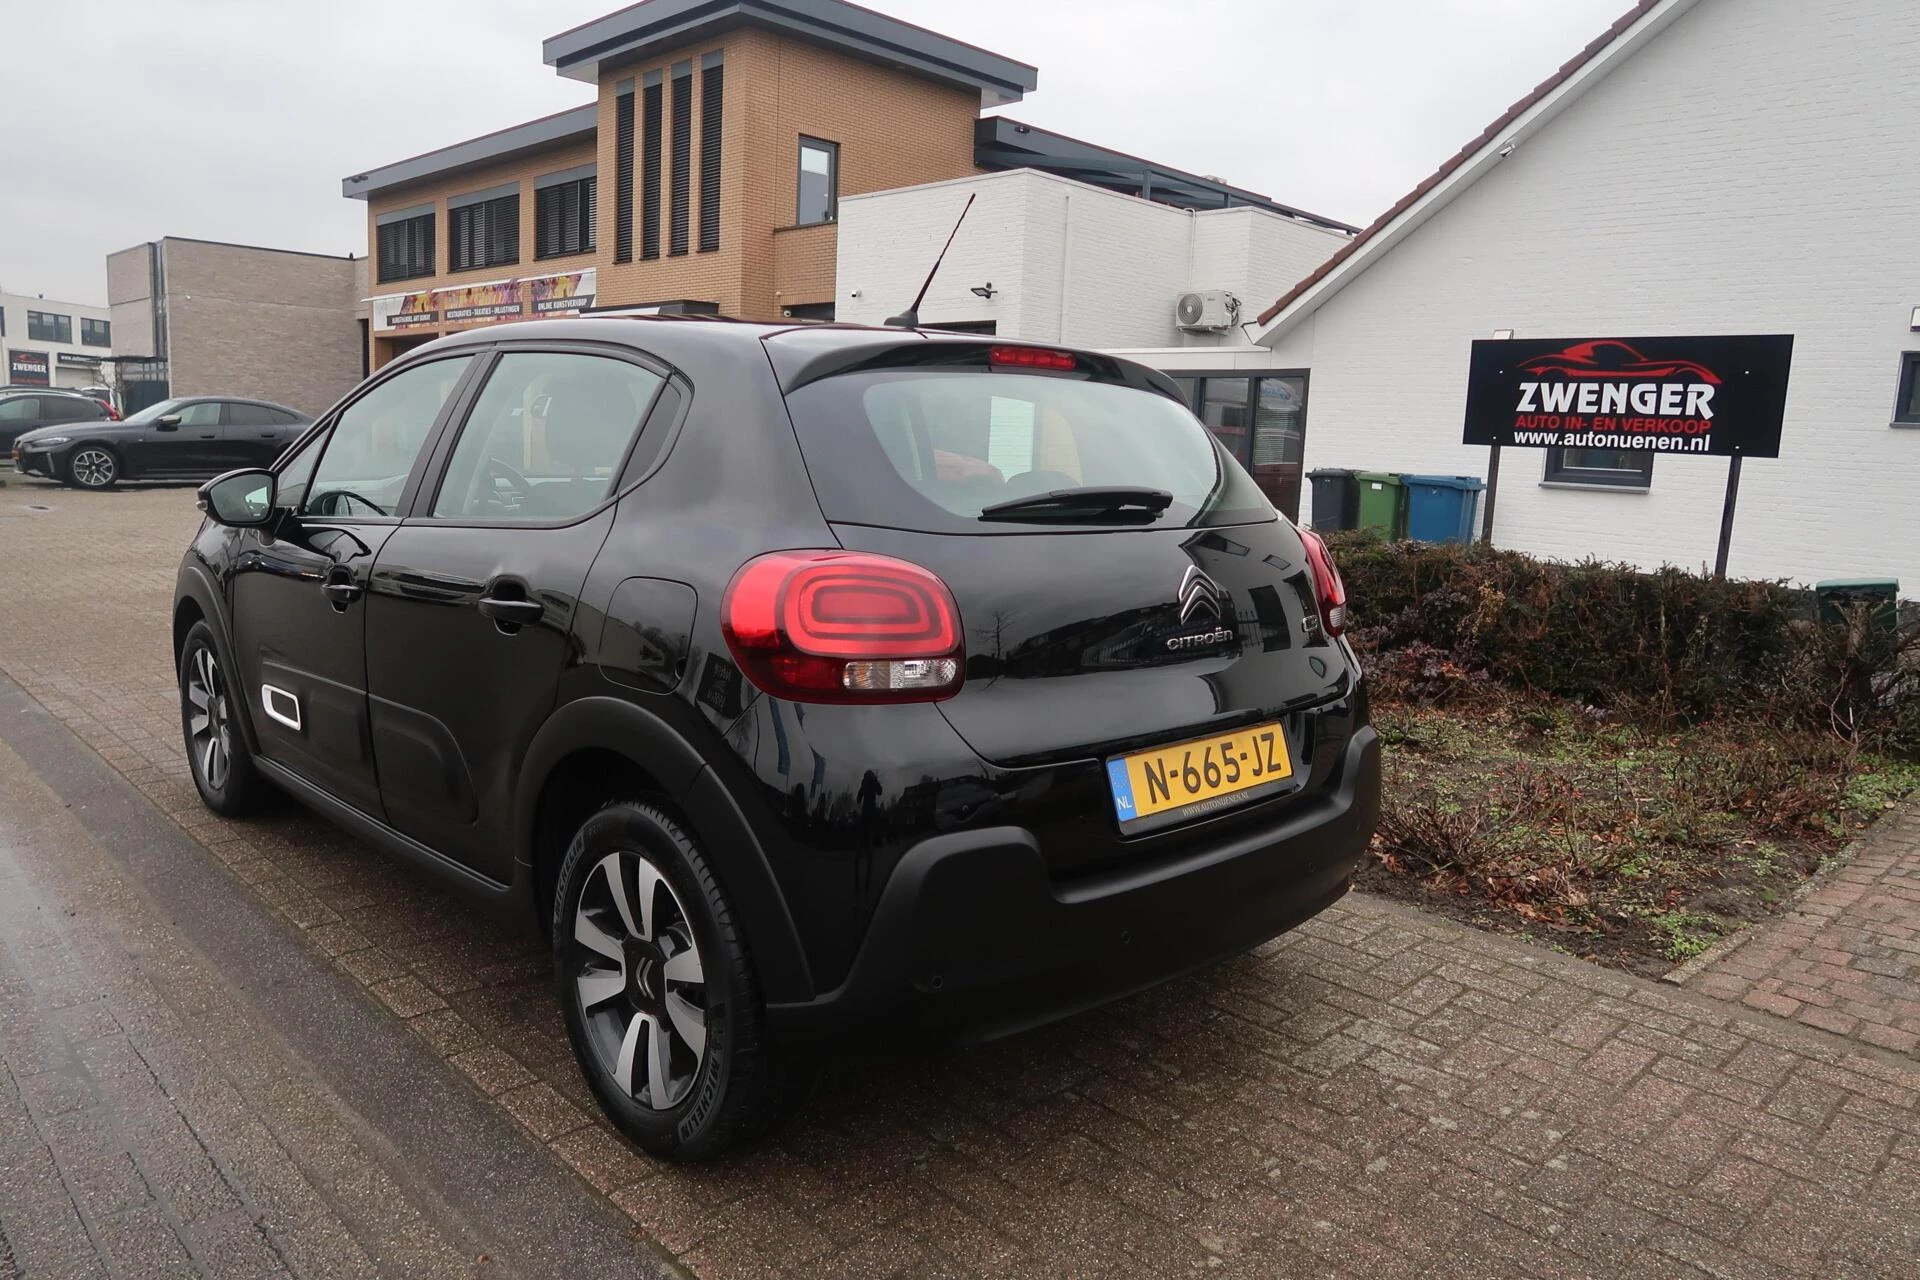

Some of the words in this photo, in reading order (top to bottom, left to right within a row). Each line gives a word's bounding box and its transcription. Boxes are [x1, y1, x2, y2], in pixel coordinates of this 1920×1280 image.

[12, 362, 48, 374] ZWENGER
[1515, 382, 1716, 420] ZWENGER
[1515, 415, 1561, 430] AUTO
[1564, 416, 1588, 431] IN-
[1593, 417, 1617, 431] EN
[1622, 417, 1712, 434] VERKOOP
[1514, 431, 1710, 452] www.autonuenen.nl
[1143, 731, 1282, 805] N-665-JZ
[1117, 796, 1133, 811] NL
[553, 833, 584, 918] MICHELIN
[680, 1056, 720, 1141] MICHELIN
